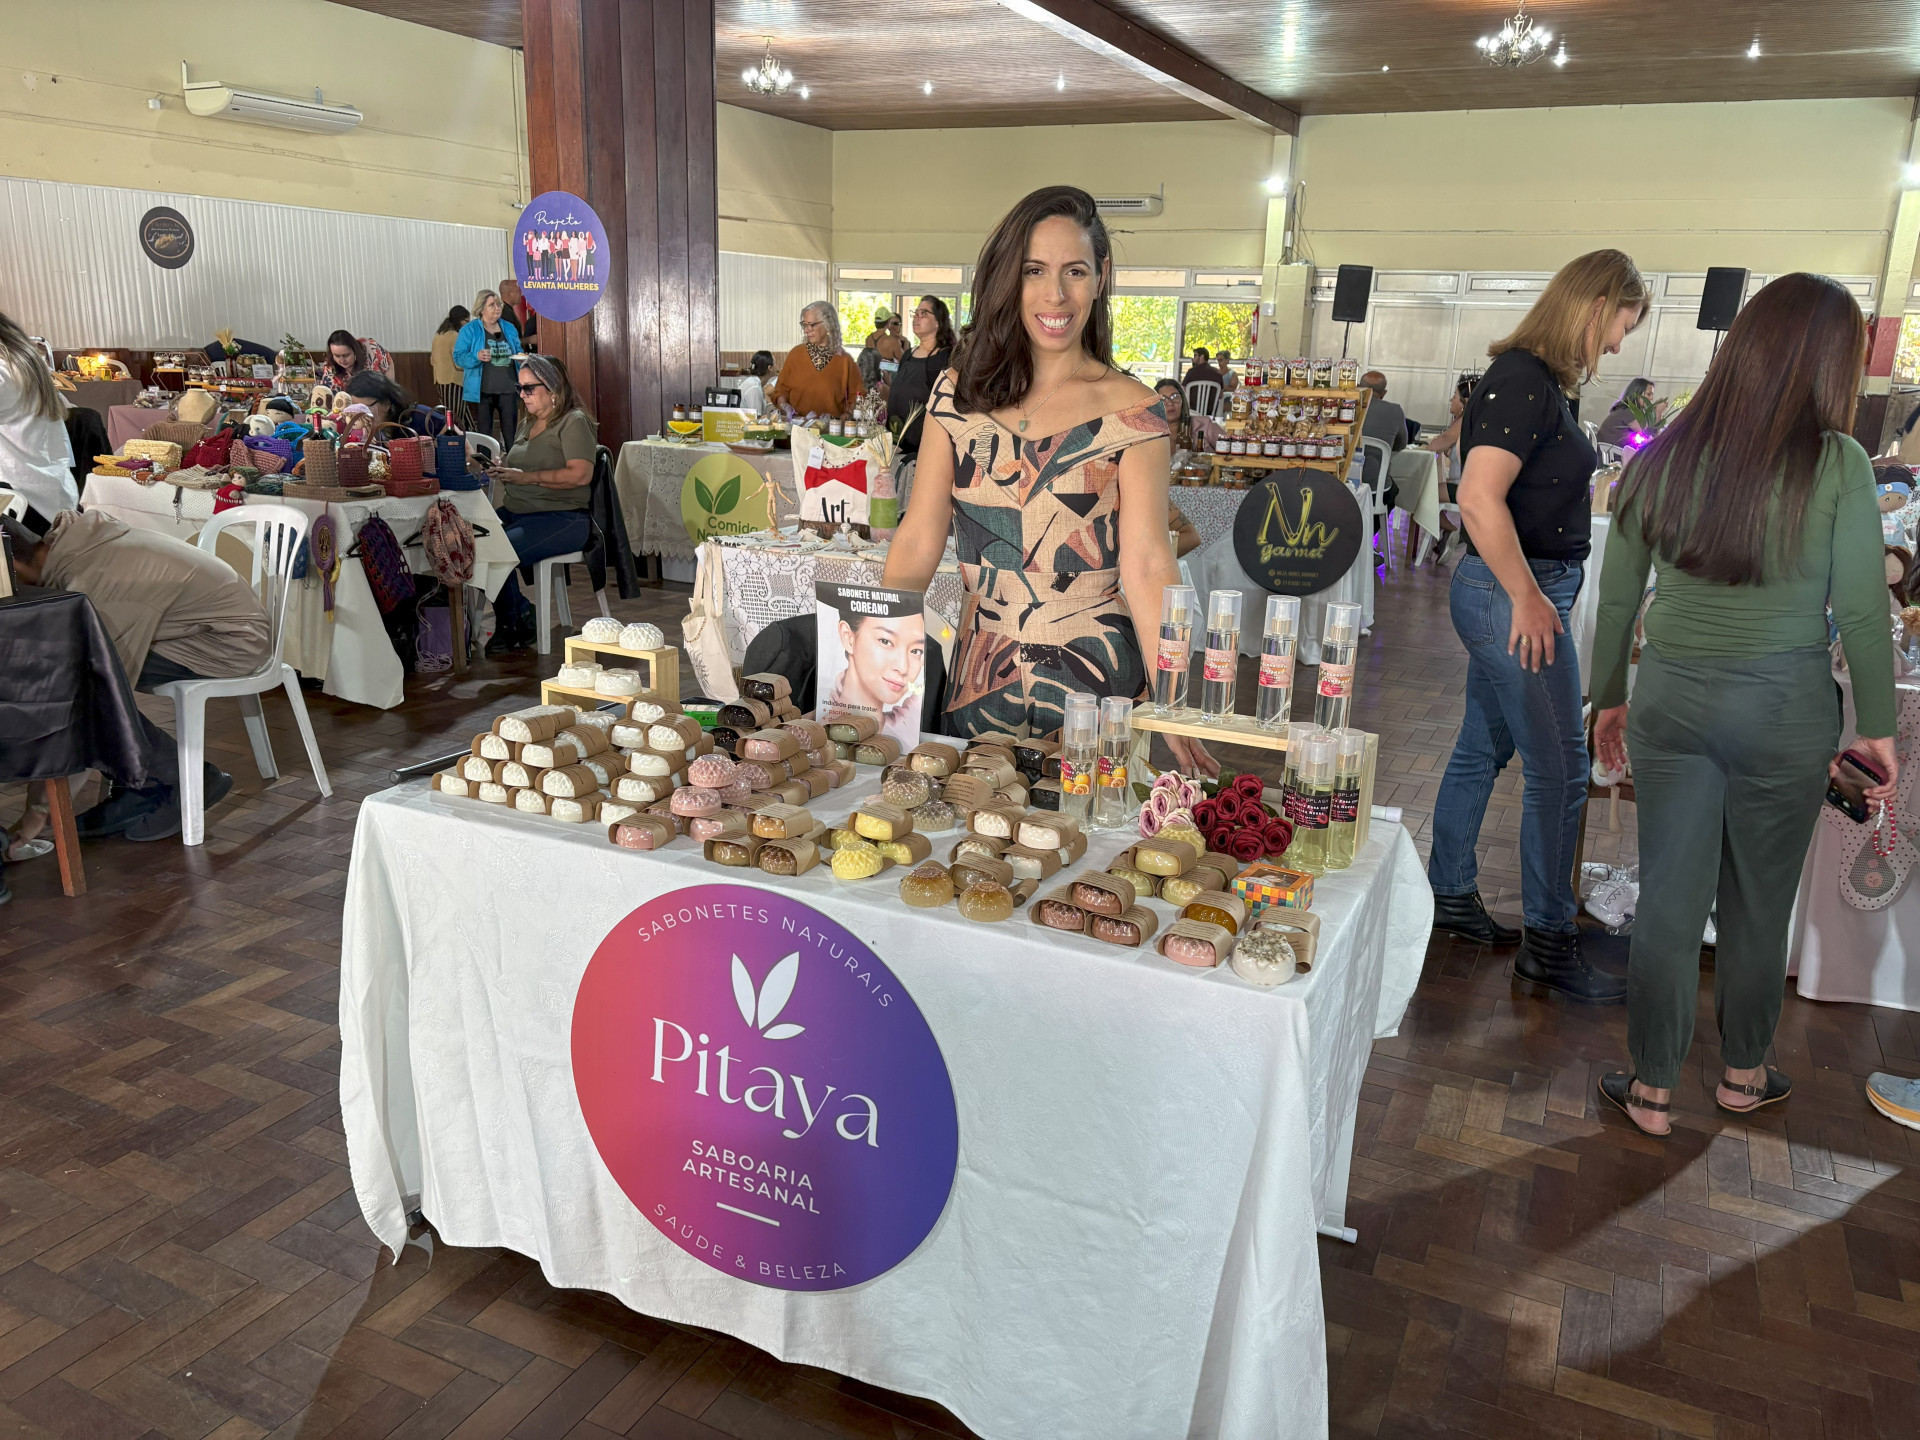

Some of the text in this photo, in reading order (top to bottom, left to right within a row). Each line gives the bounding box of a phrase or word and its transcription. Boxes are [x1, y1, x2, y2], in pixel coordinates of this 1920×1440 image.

[534, 210, 583, 230] Projeto
[523, 281, 600, 291] LEVANTA MULHERES
[838, 587, 900, 603] SABONETE NATURAL
[850, 600, 889, 615] COREANO
[637, 903, 895, 1009] SABONETES NATURAIS
[649, 1016, 881, 1150] Pitaya
[682, 1158, 821, 1216] ARTESANAL
[691, 1140, 815, 1192] SABOARIA
[653, 1203, 848, 1281] SAÚDE & BELEZA
